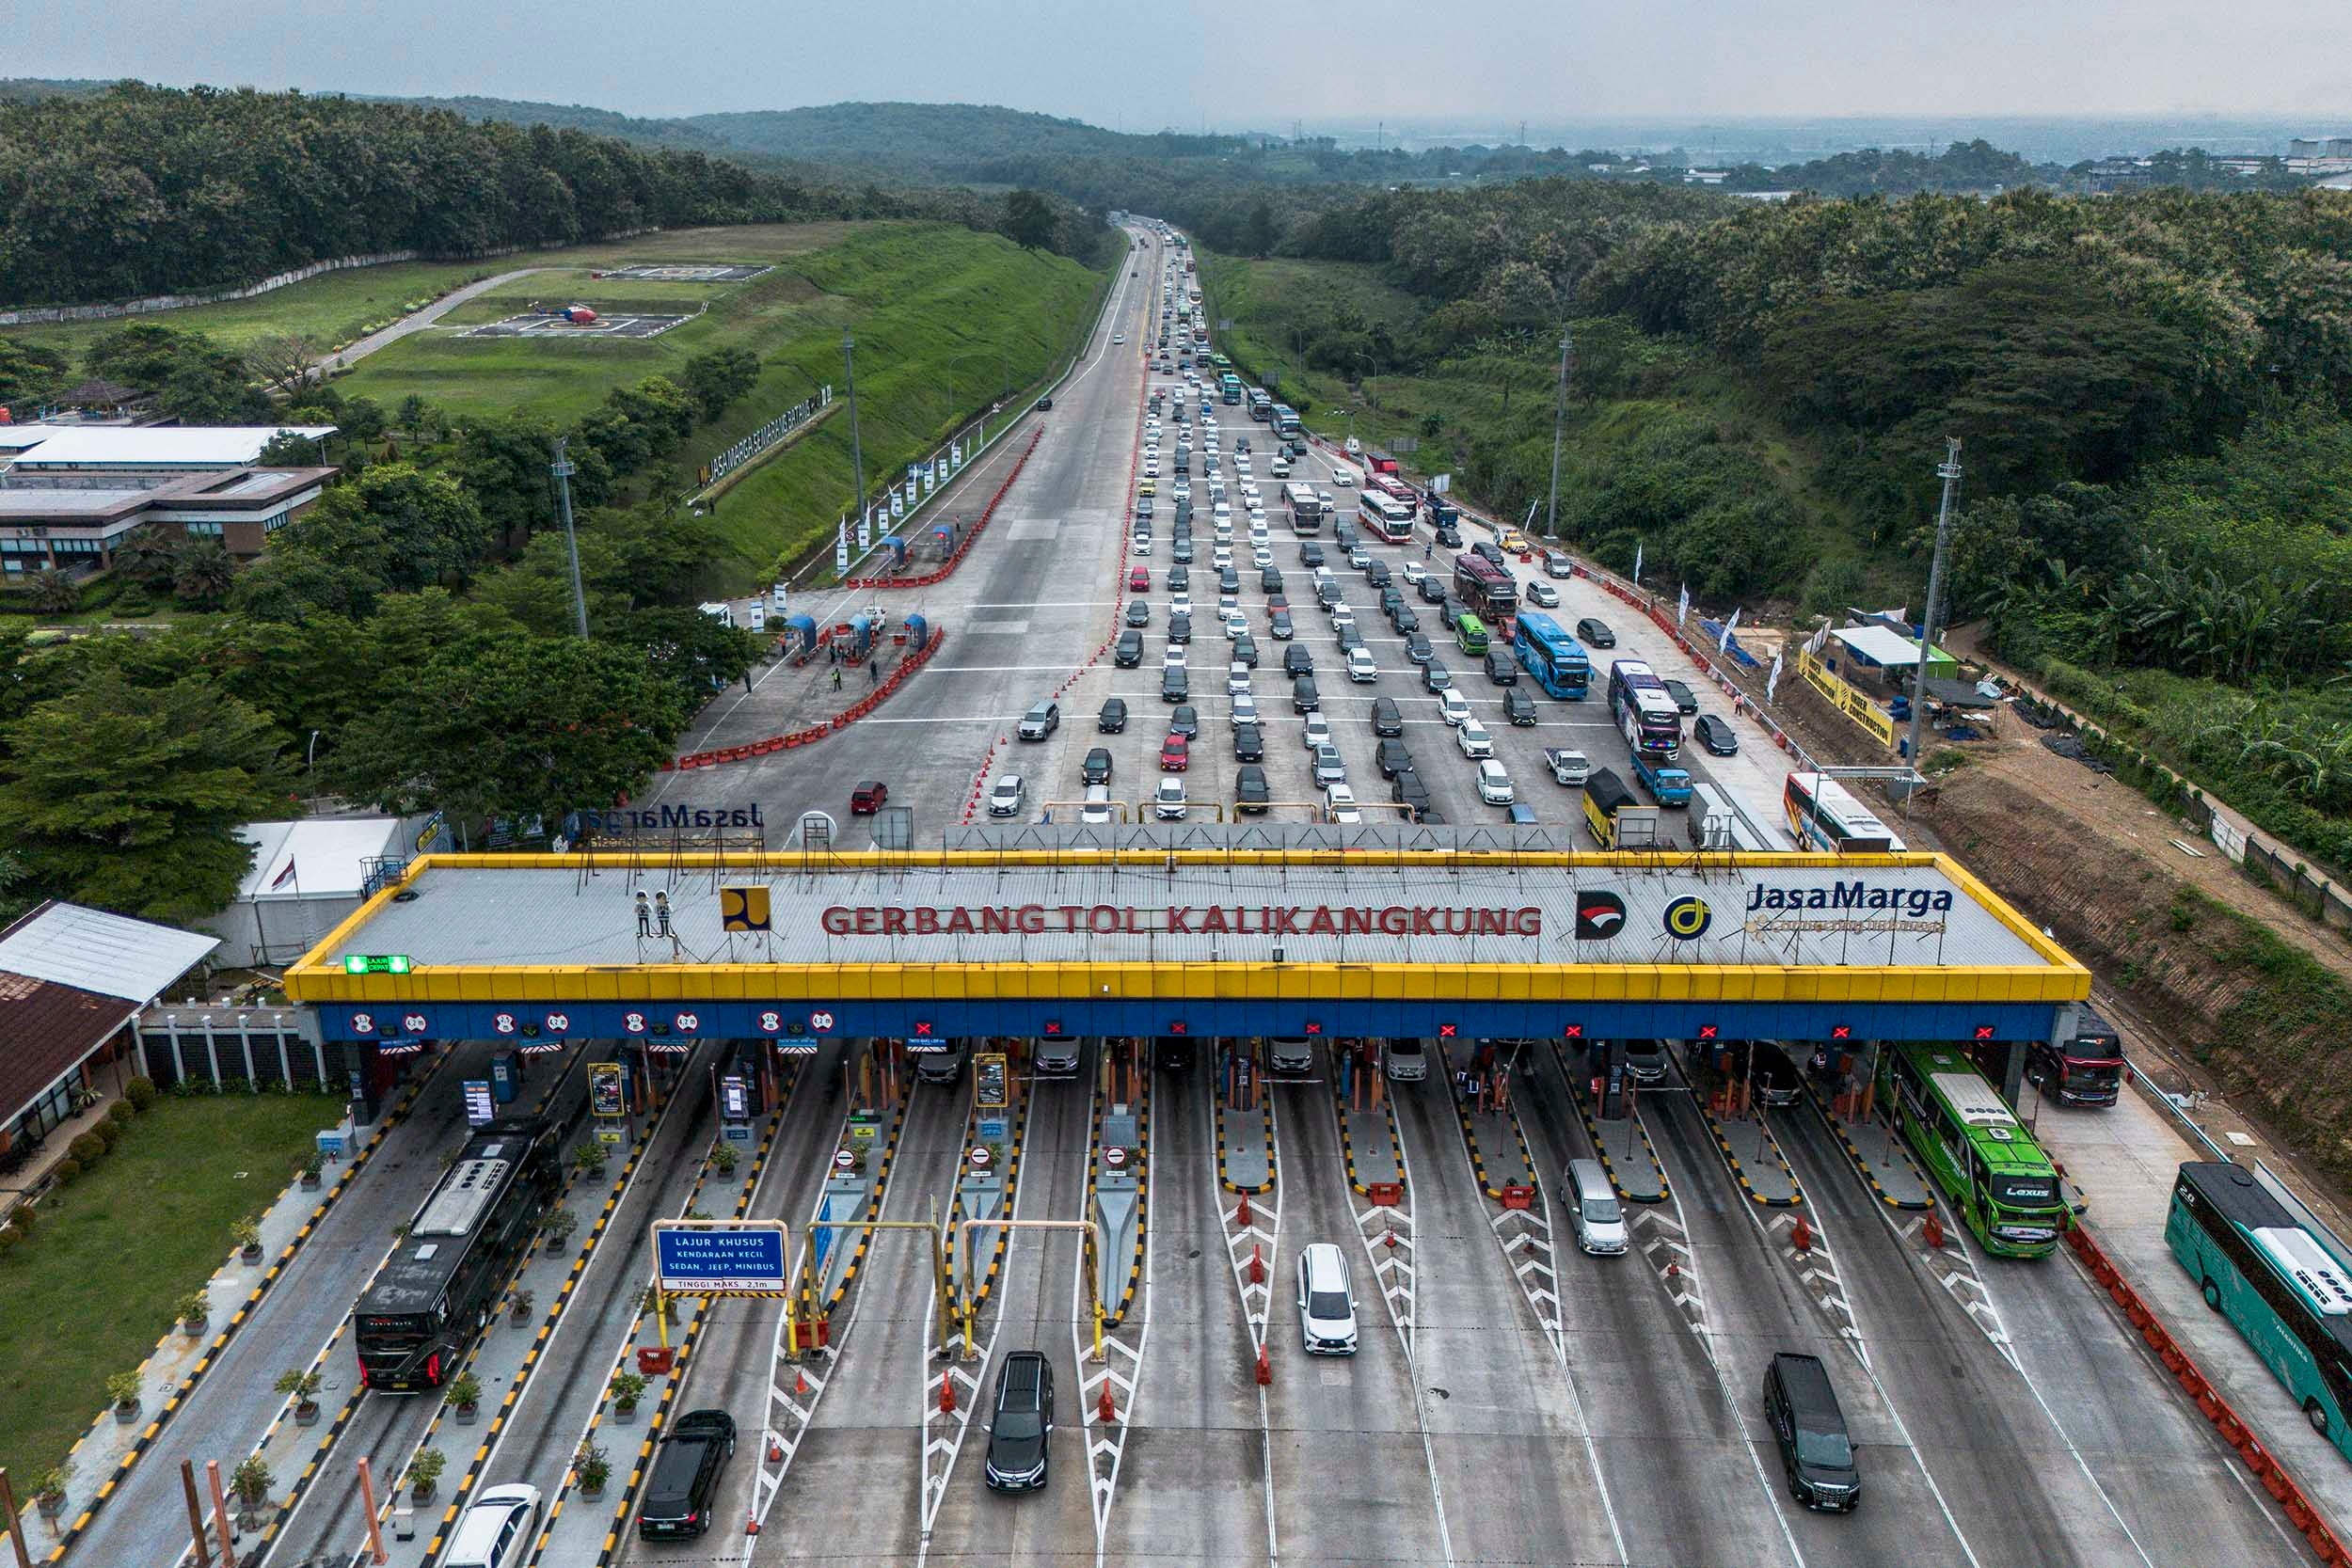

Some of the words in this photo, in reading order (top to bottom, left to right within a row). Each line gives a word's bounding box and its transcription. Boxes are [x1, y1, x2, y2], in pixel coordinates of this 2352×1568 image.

[709, 452, 728, 482] JASA
[1851, 691, 1867, 712] UNDER
[1849, 704, 1888, 740] CONSTRUCTION
[1747, 881, 1953, 918] JasaMarga
[821, 904, 1045, 935] GERBANG
[1058, 904, 1145, 935] TOL
[1167, 905, 1543, 936] KALIKANGKUNG
[2006, 1187, 2049, 1197] Lexus
[2179, 1184, 2196, 1203] 2.0
[675, 1238, 711, 1246] LAJUR
[718, 1238, 765, 1246] KHUSUS
